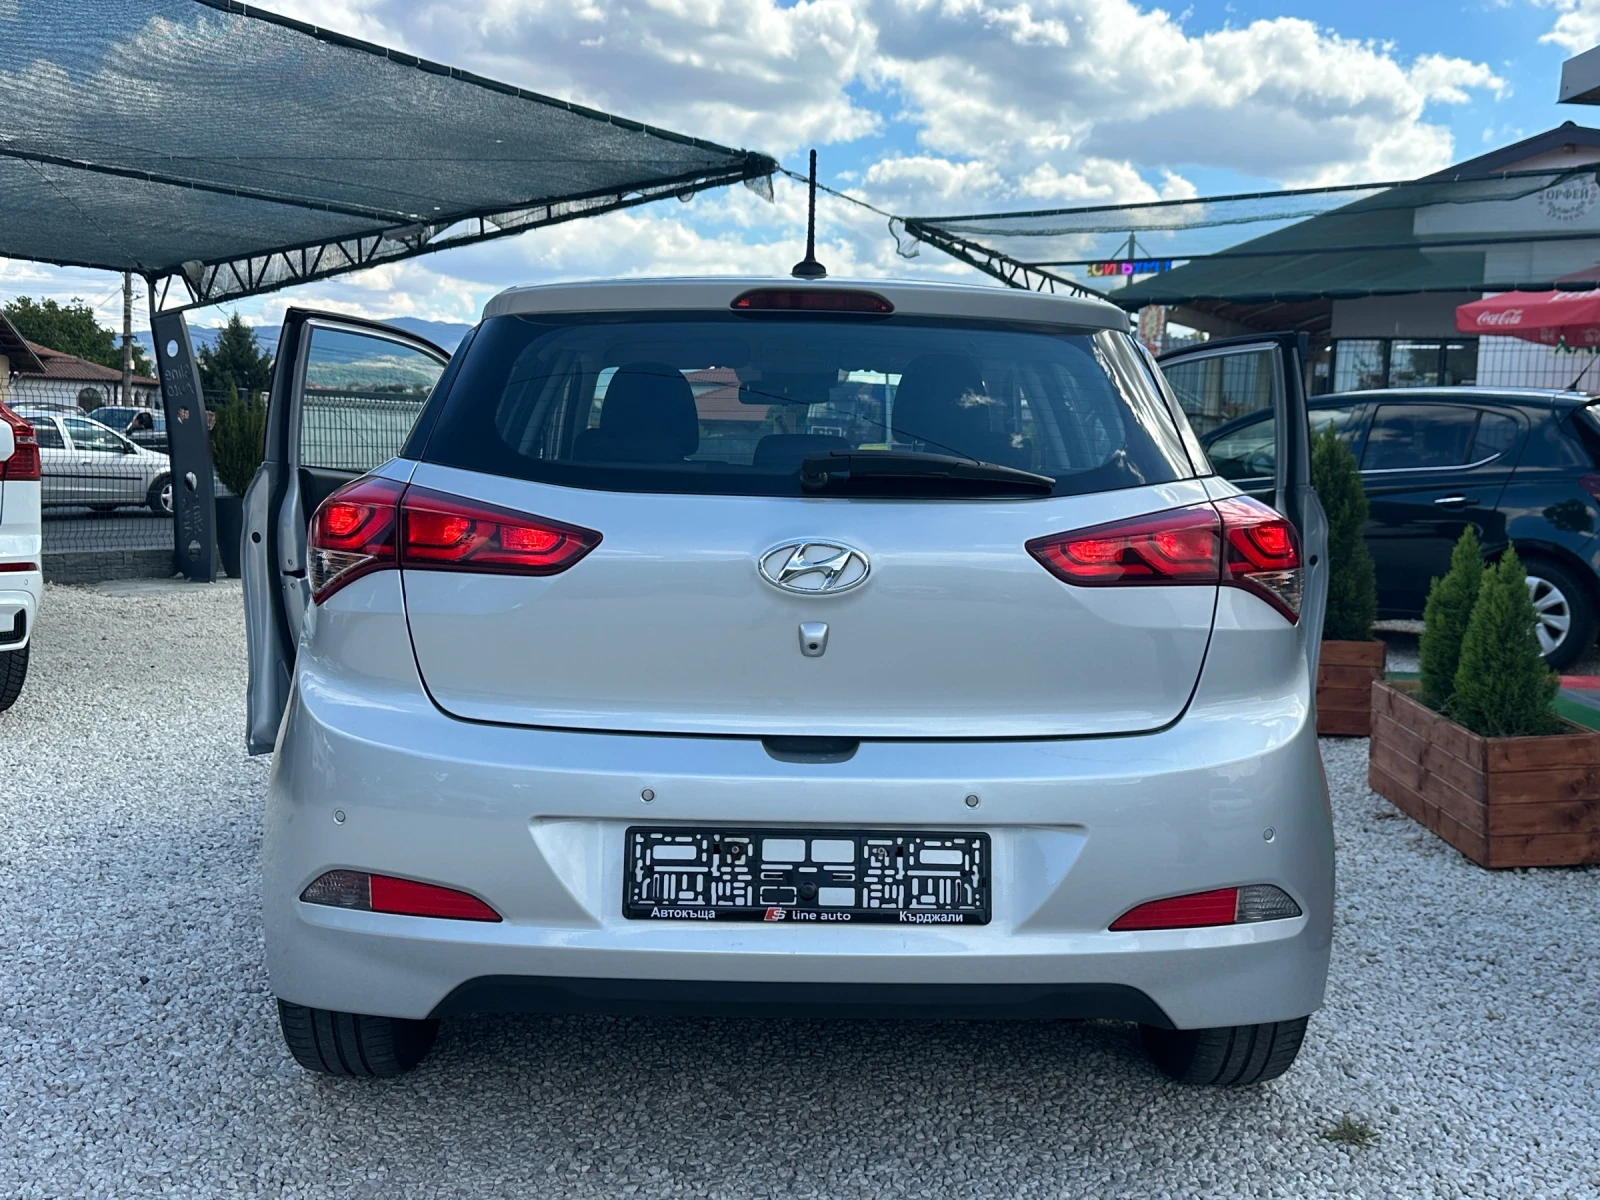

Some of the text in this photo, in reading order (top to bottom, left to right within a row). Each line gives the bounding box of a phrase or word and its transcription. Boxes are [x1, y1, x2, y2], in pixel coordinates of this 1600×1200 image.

[1546, 186, 1589, 201] ОРФЕЙ
[650, 906, 716, 920] Автокъща
[792, 910, 817, 921] line
[820, 911, 851, 922] auto
[899, 911, 964, 923] Кърджали
